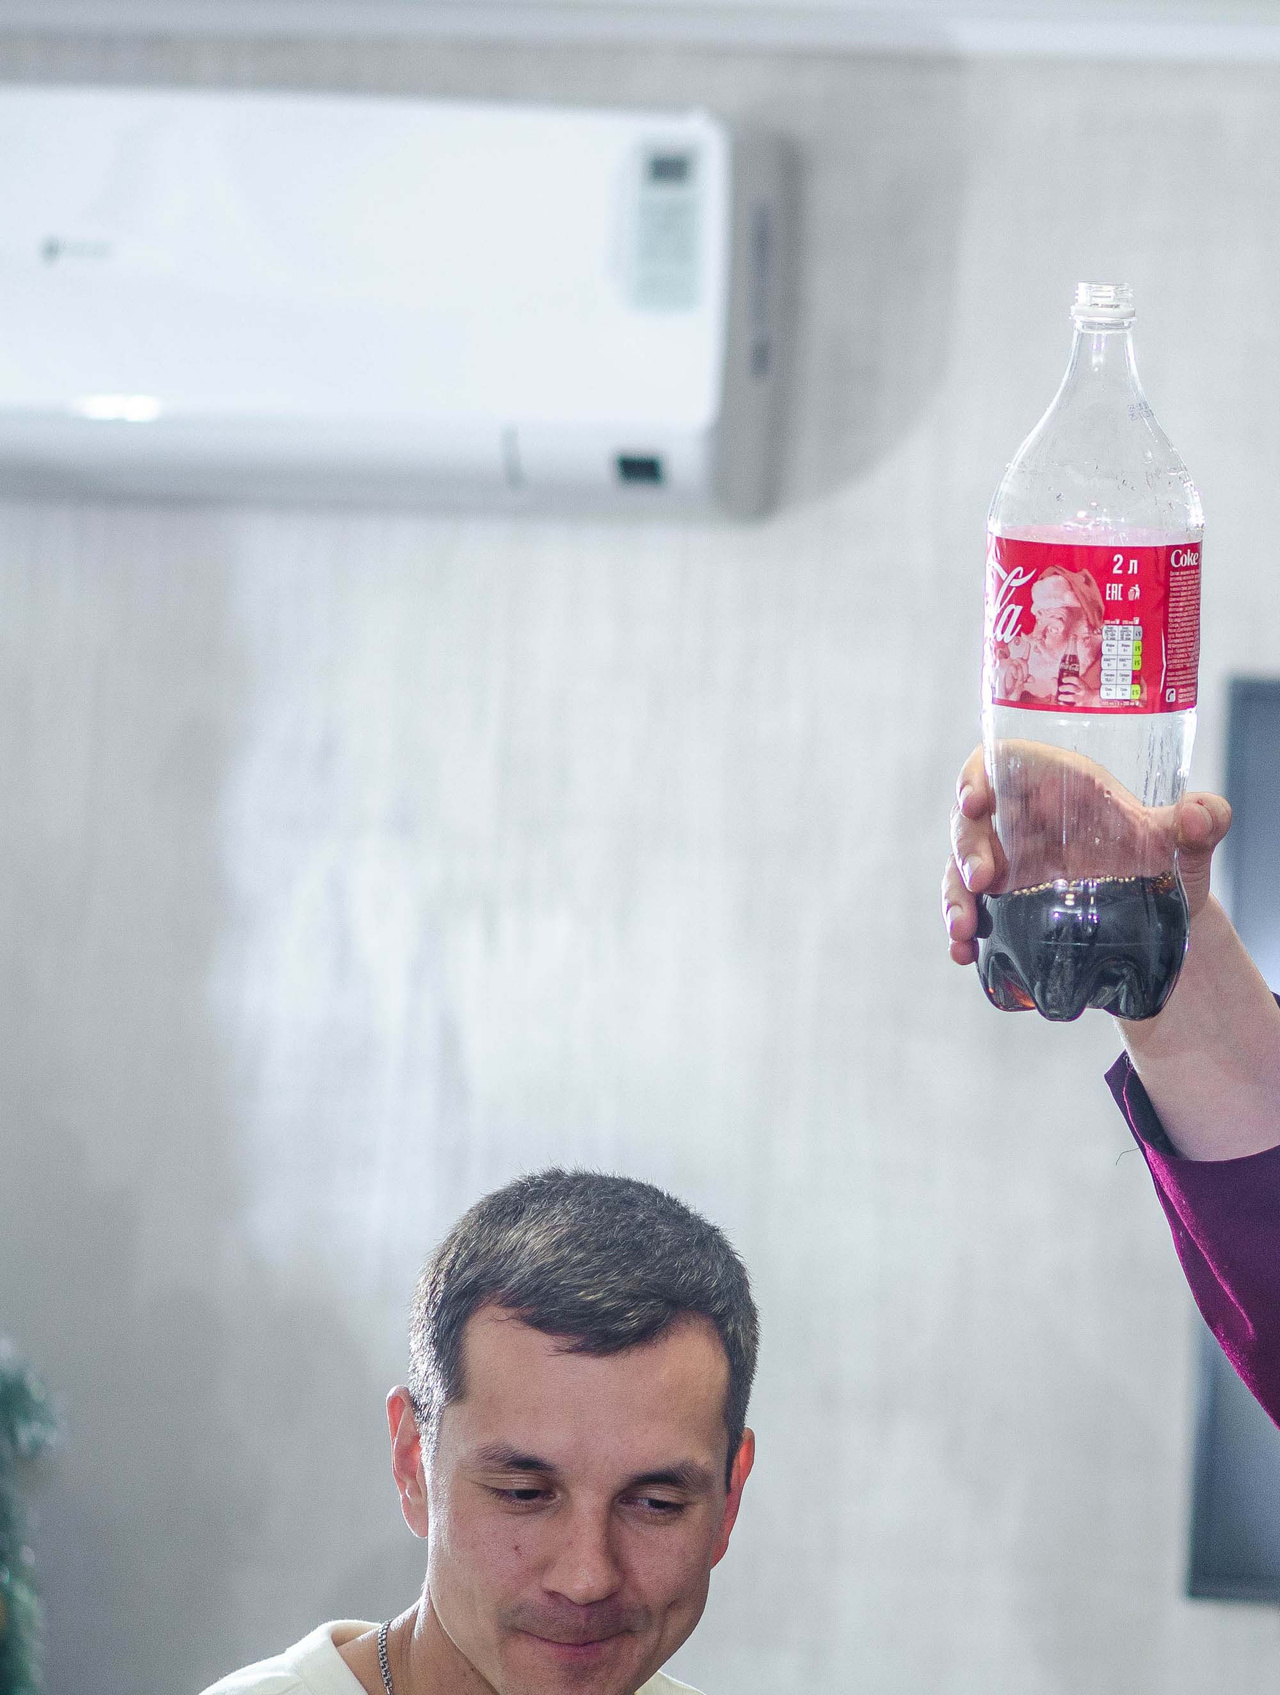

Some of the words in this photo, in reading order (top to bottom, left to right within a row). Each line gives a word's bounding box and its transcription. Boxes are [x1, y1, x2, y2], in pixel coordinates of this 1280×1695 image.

[1113, 554, 1123, 575] 2
[1128, 559, 1138, 575] л
[1170, 549, 1199, 568] Coke
[1106, 583, 1123, 601] EAC
[992, 566, 1036, 643] la
